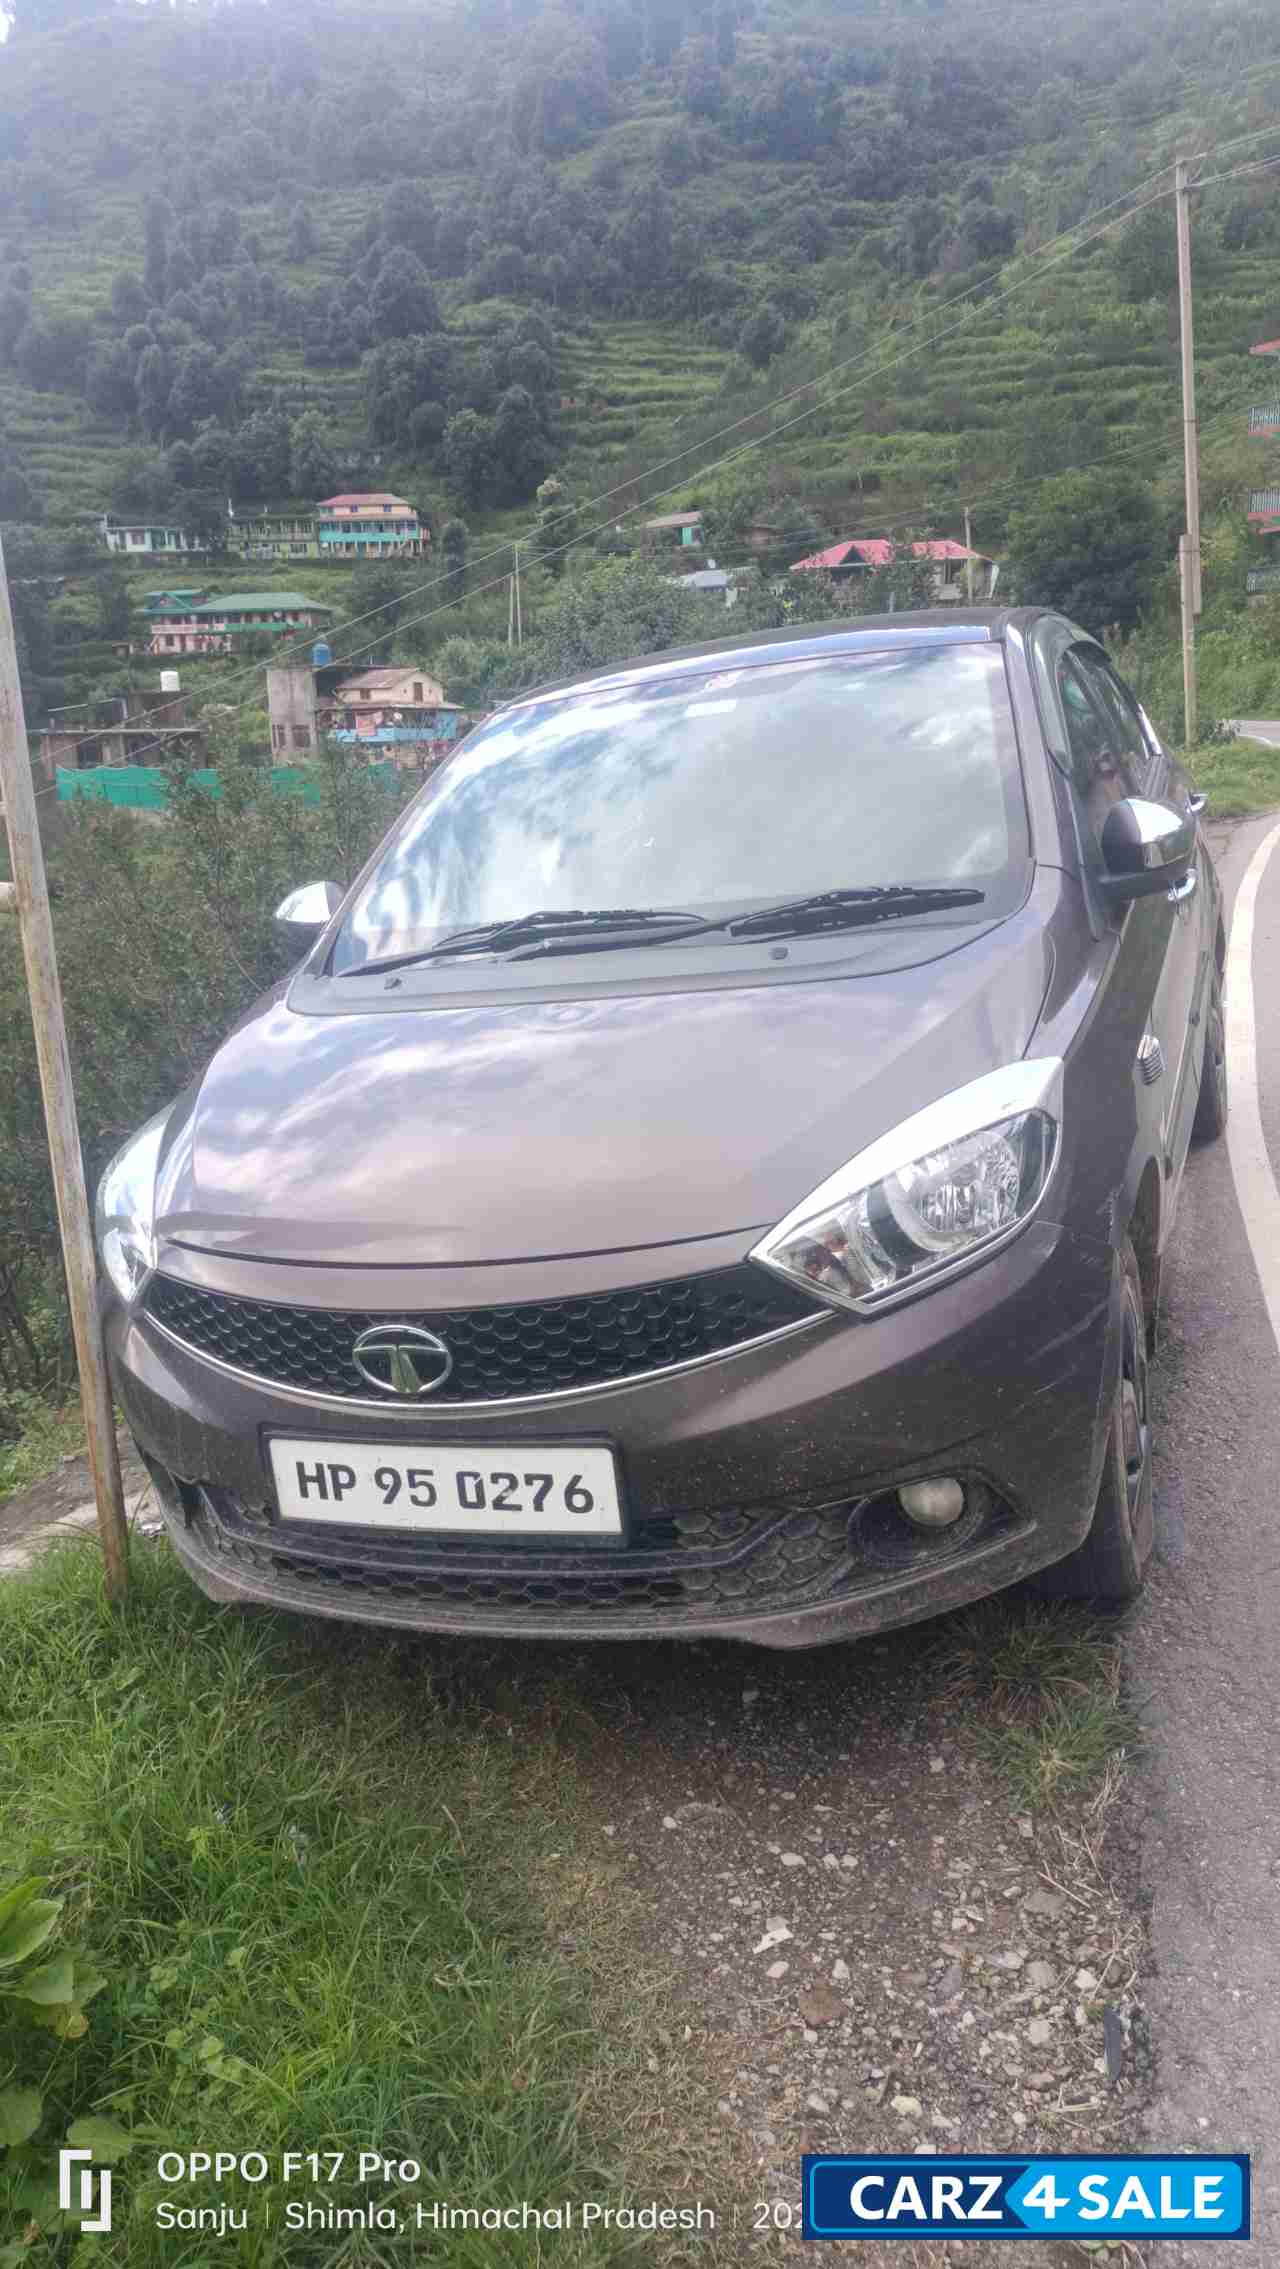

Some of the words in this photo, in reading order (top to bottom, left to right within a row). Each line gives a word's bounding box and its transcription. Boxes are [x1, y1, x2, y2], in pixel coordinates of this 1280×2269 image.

[295, 1461, 357, 1501] HP
[374, 1467, 437, 1507] 95
[456, 1471, 595, 1514] 0276
